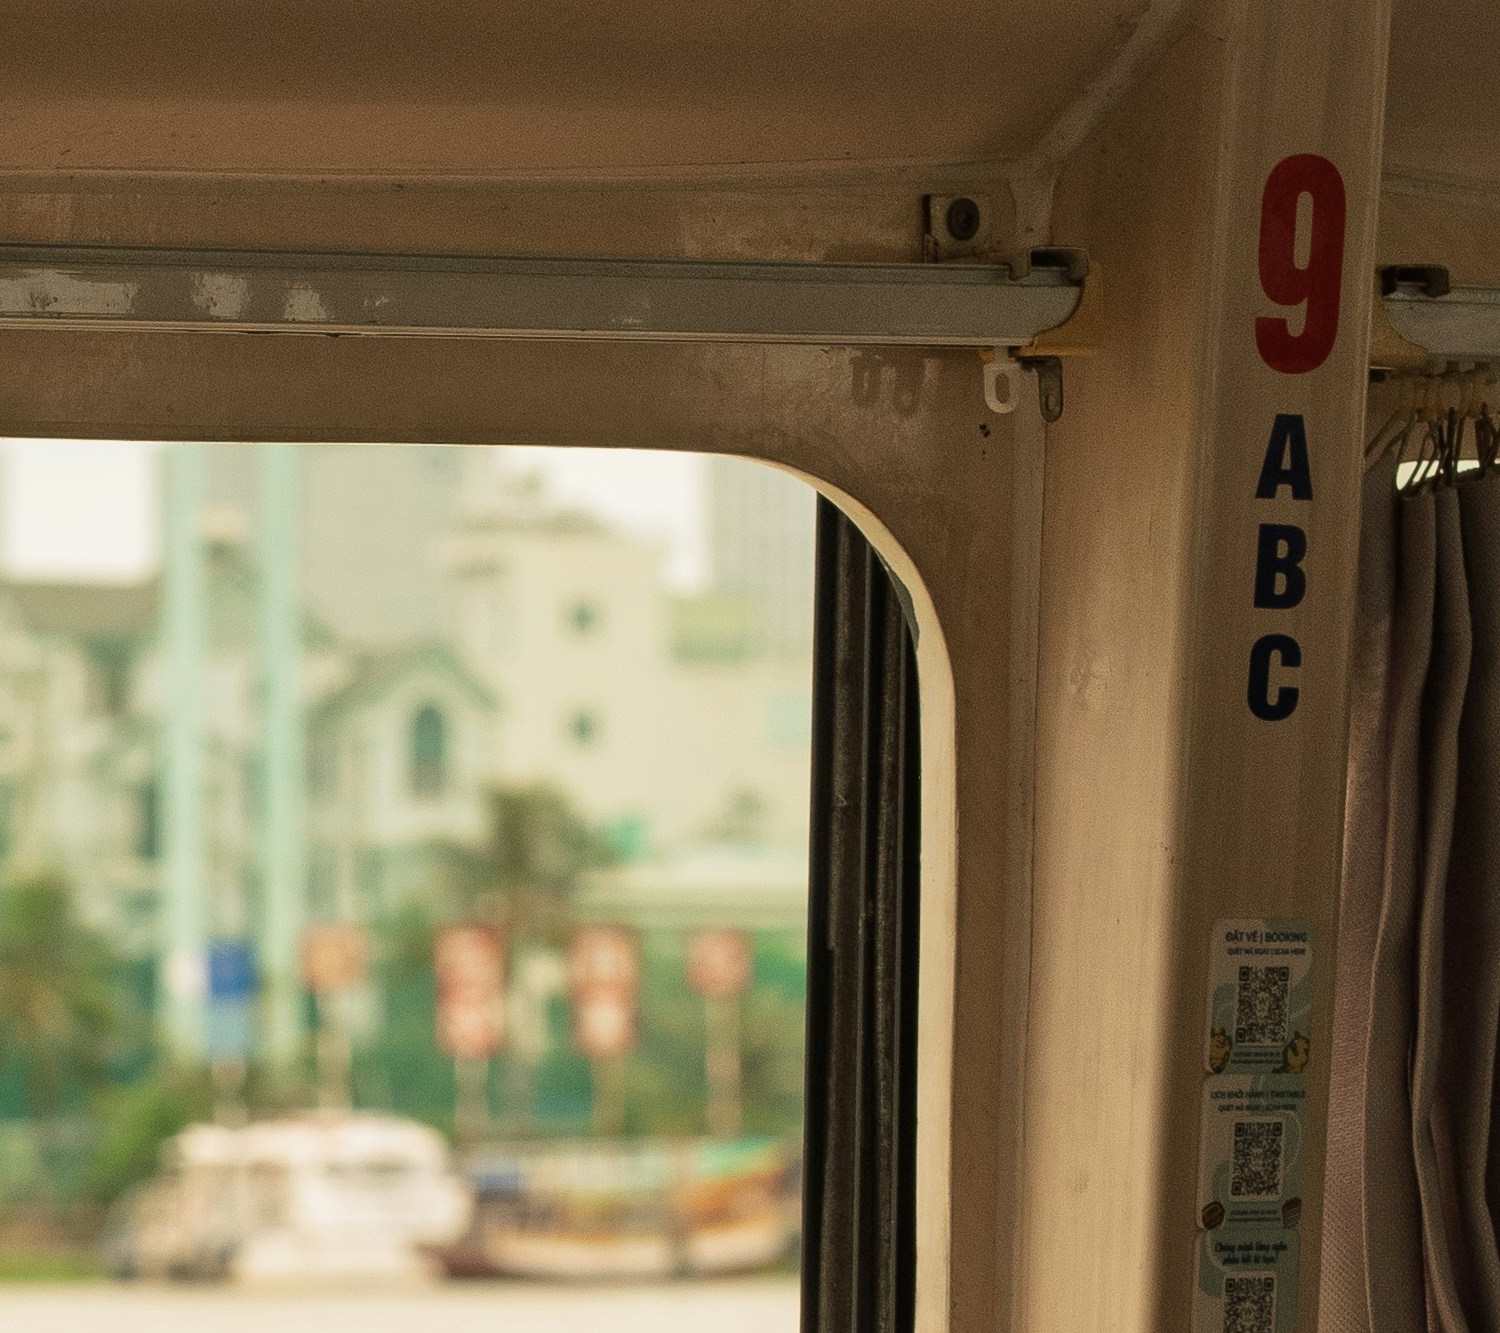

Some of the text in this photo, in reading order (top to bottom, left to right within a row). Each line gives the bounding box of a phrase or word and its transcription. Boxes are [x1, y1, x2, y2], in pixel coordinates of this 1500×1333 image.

[1255, 153, 1346, 374] 9
[1255, 413, 1313, 501] A
[1253, 522, 1308, 609] B
[1247, 633, 1302, 722] C
[1265, 931, 1308, 942] BOOKING
